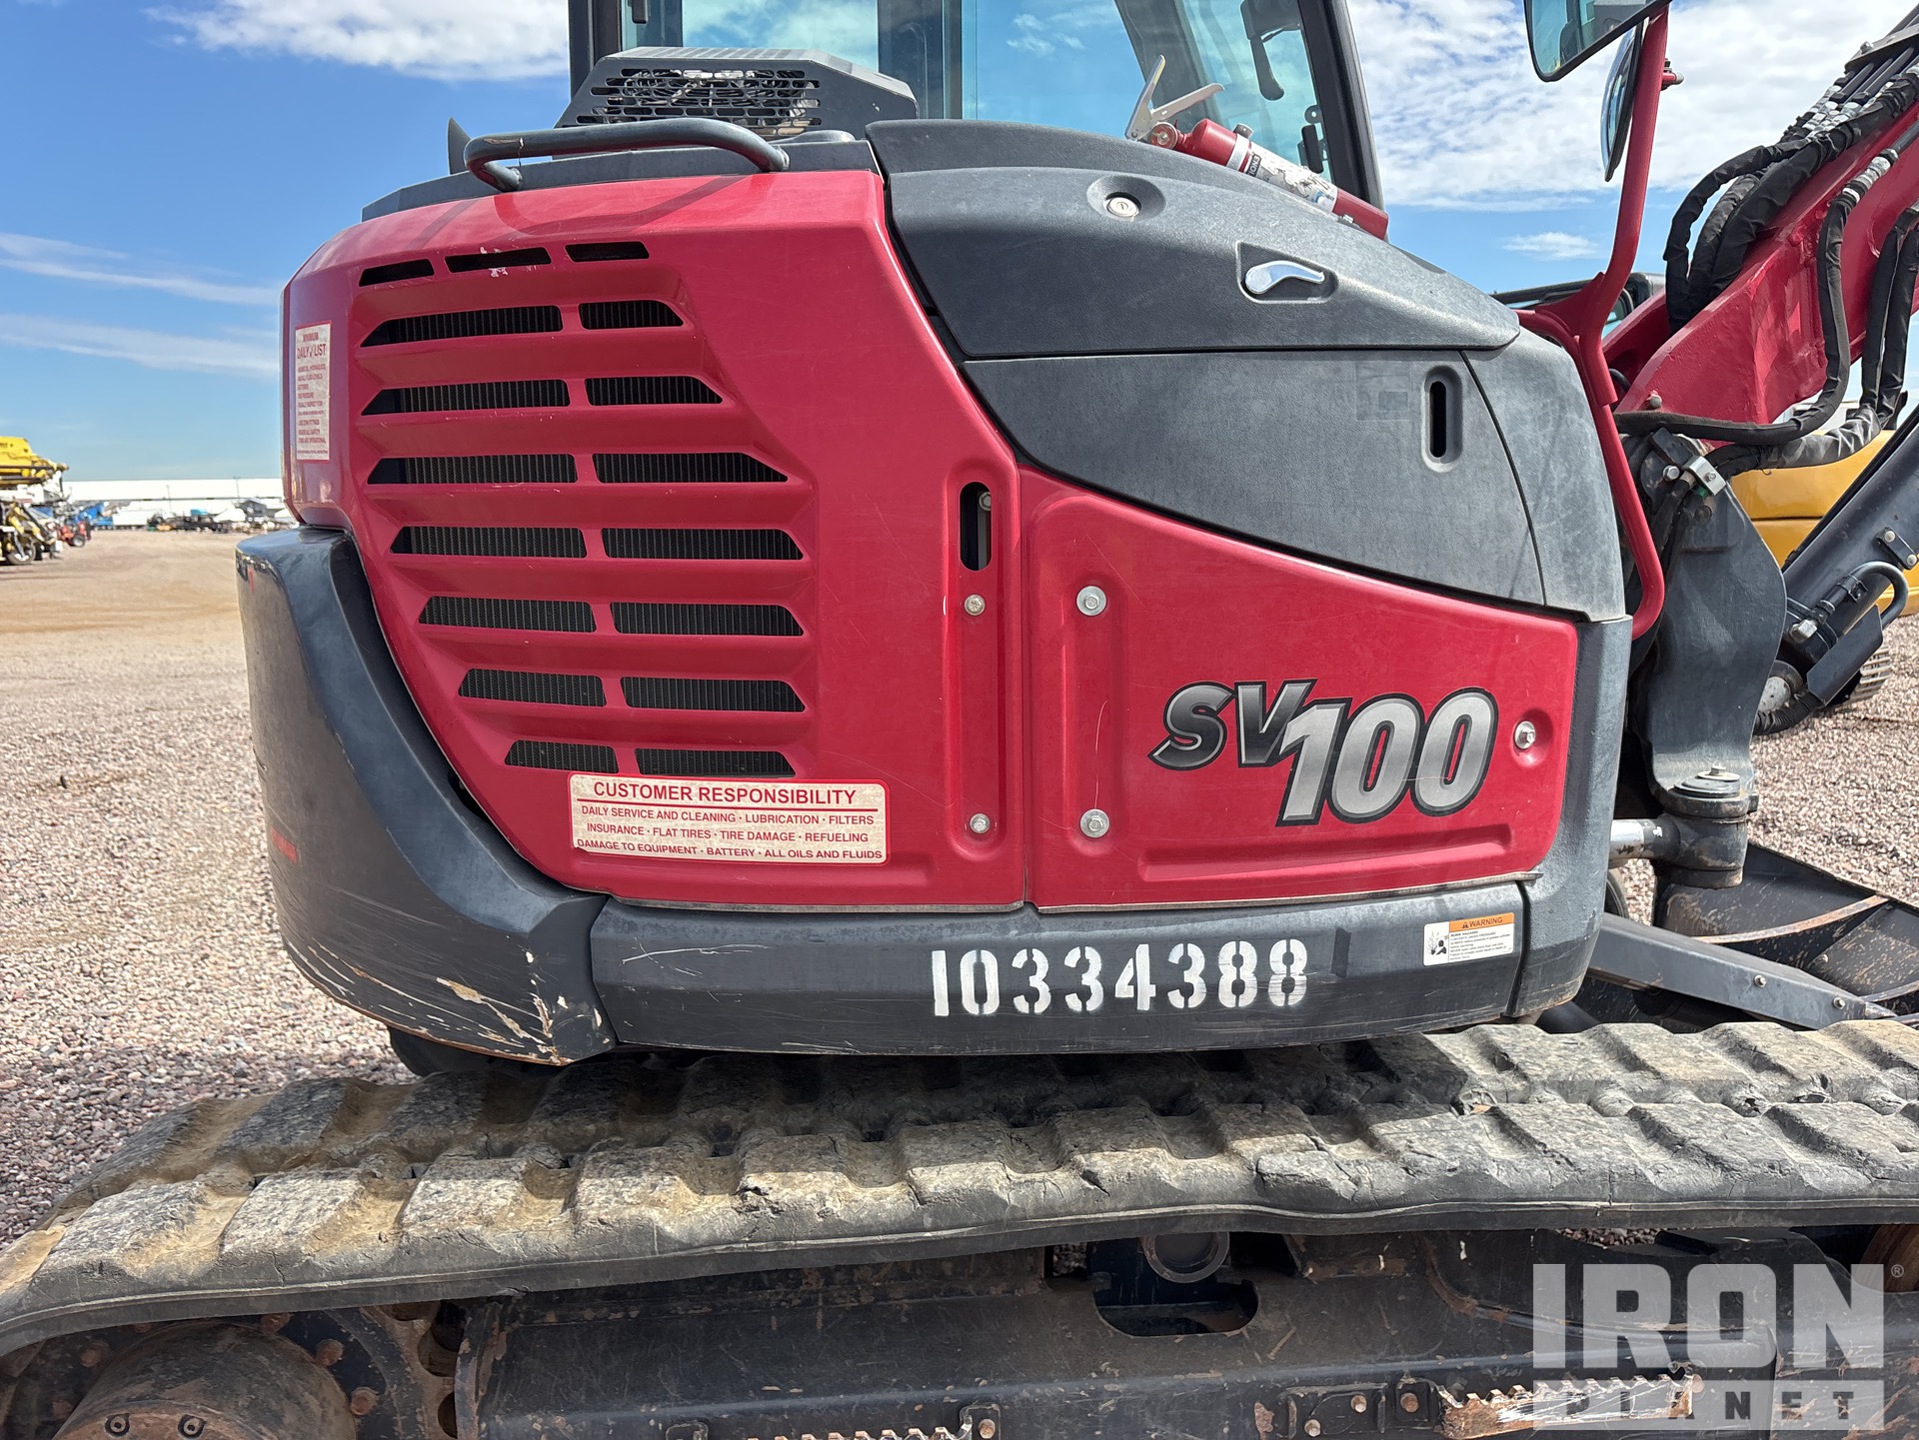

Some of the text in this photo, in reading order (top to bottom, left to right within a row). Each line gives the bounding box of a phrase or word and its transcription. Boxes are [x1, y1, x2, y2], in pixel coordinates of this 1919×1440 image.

[314, 343, 326, 356] LIST
[1147, 679, 1499, 827] SV100
[594, 781, 856, 804] CUSTOMER RESPONSIBILITY
[582, 805, 874, 825] DAILY SERVICE AND CLEANING LUBRICATION FILTERS
[587, 823, 868, 842] INSURANCE FLAT TIRES TIRE DAMAGE REFUELING
[577, 839, 882, 859] DAMAGE TO EQUIPMENT BATTERY ALL OILS AND FLUIDS
[1469, 916, 1503, 928] WARNING
